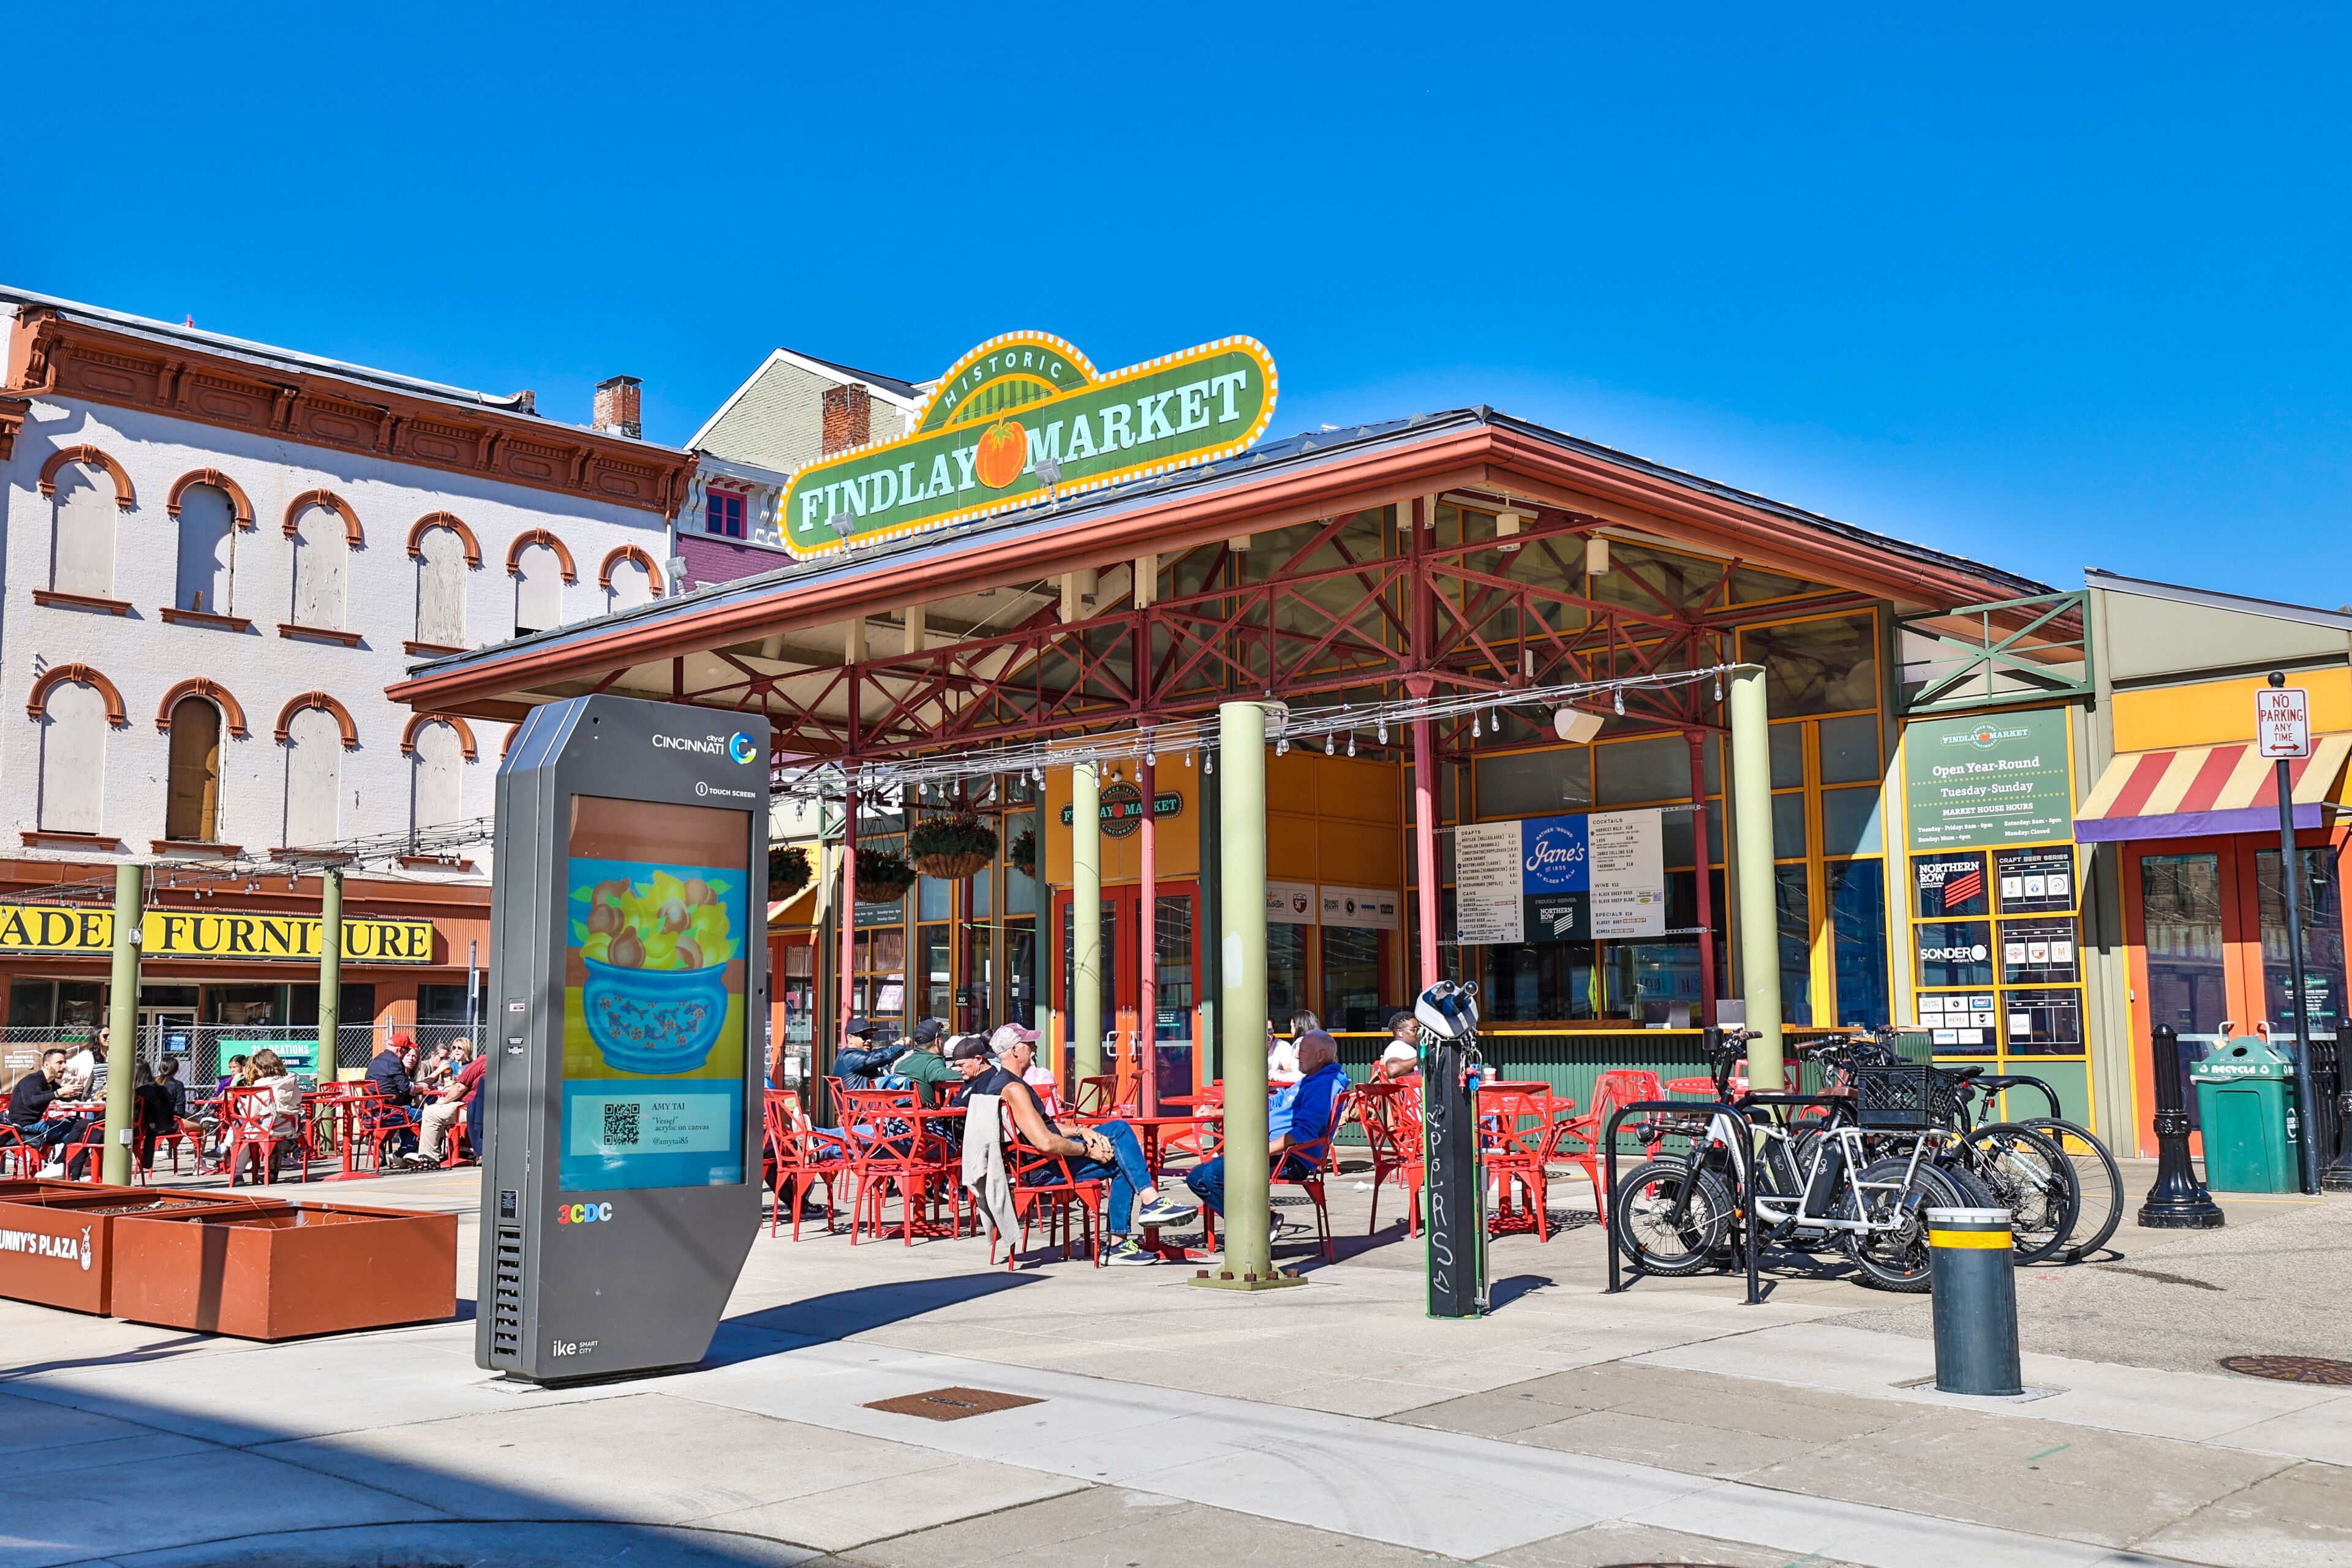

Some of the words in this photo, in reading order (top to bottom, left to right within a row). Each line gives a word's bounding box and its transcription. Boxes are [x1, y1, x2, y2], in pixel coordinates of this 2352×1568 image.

[944, 351, 1063, 410] HISTORIC
[799, 445, 978, 533] FINDLAY
[1022, 369, 1248, 474] MARKET
[2272, 696, 2290, 708] NO
[2261, 709, 2303, 722] PARKING
[1973, 725, 1986, 733] SINCE
[2274, 723, 2292, 732] ANY
[1943, 734, 1981, 744] FINDLAY
[1989, 729, 2029, 739] MARKET
[1973, 739, 1997, 748] CINCINNATI
[2274, 733, 2293, 741] TIME
[652, 734, 724, 755] CINCINNATI
[1932, 765, 1965, 778] Open
[1966, 756, 2040, 773] Year-Round
[709, 788, 731, 796] TOUCH
[732, 790, 756, 799] SCREEN
[1102, 786, 1120, 800] SINCE
[1940, 782, 2034, 798] Tuesday-Sunday
[1125, 799, 1177, 815] MAKET
[1942, 807, 1976, 816] MARKET
[1977, 805, 2004, 814] HOUSE
[2005, 802, 2034, 812] HOURS
[1102, 821, 1136, 835] CINCINNATI
[1536, 827, 1554, 840] GATHER
[1526, 841, 1585, 871] Jane's
[1919, 861, 1980, 873] NORTHERN
[1565, 869, 1575, 880] ELM
[1919, 872, 1946, 883] ROW
[0, 910, 115, 948] ADE
[1920, 947, 1975, 962] SONDER
[2211, 1065, 2256, 1074] RECYCLE
[655, 1123, 677, 1133] acrylic
[653, 1137, 688, 1146] @amytai85
[557, 1202, 612, 1224] 3CDC
[39, 1234, 78, 1260] PLAZA
[553, 1340, 577, 1357] ike
